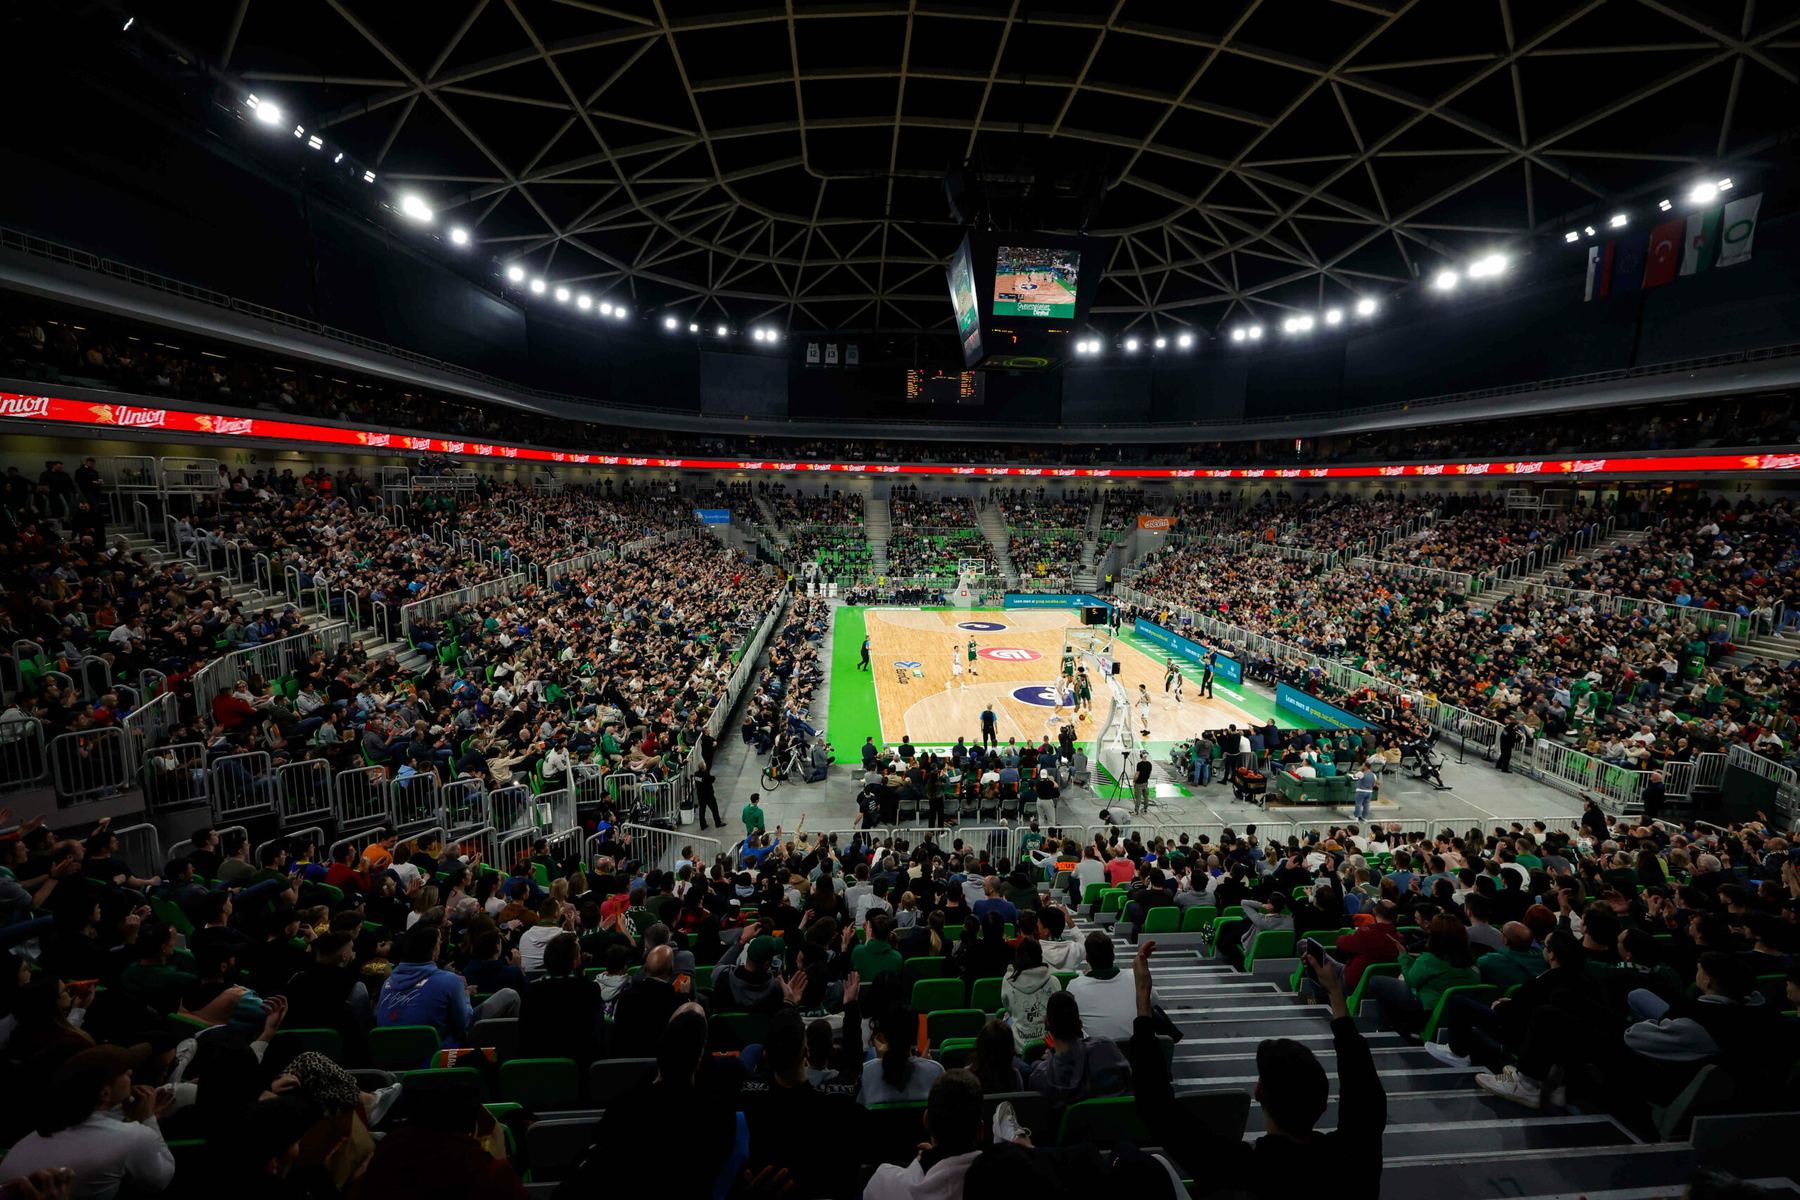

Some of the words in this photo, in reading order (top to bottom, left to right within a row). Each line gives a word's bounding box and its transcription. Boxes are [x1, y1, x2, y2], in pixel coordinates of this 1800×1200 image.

[810, 350, 817, 358] 12
[0, 395, 49, 418] nion
[115, 406, 166, 428] Union
[213, 415, 252, 435] Union
[1423, 465, 1444, 476] Union
[1465, 463, 1491, 475] Union
[1515, 461, 1544, 474] Union
[1573, 459, 1607, 473] Union
